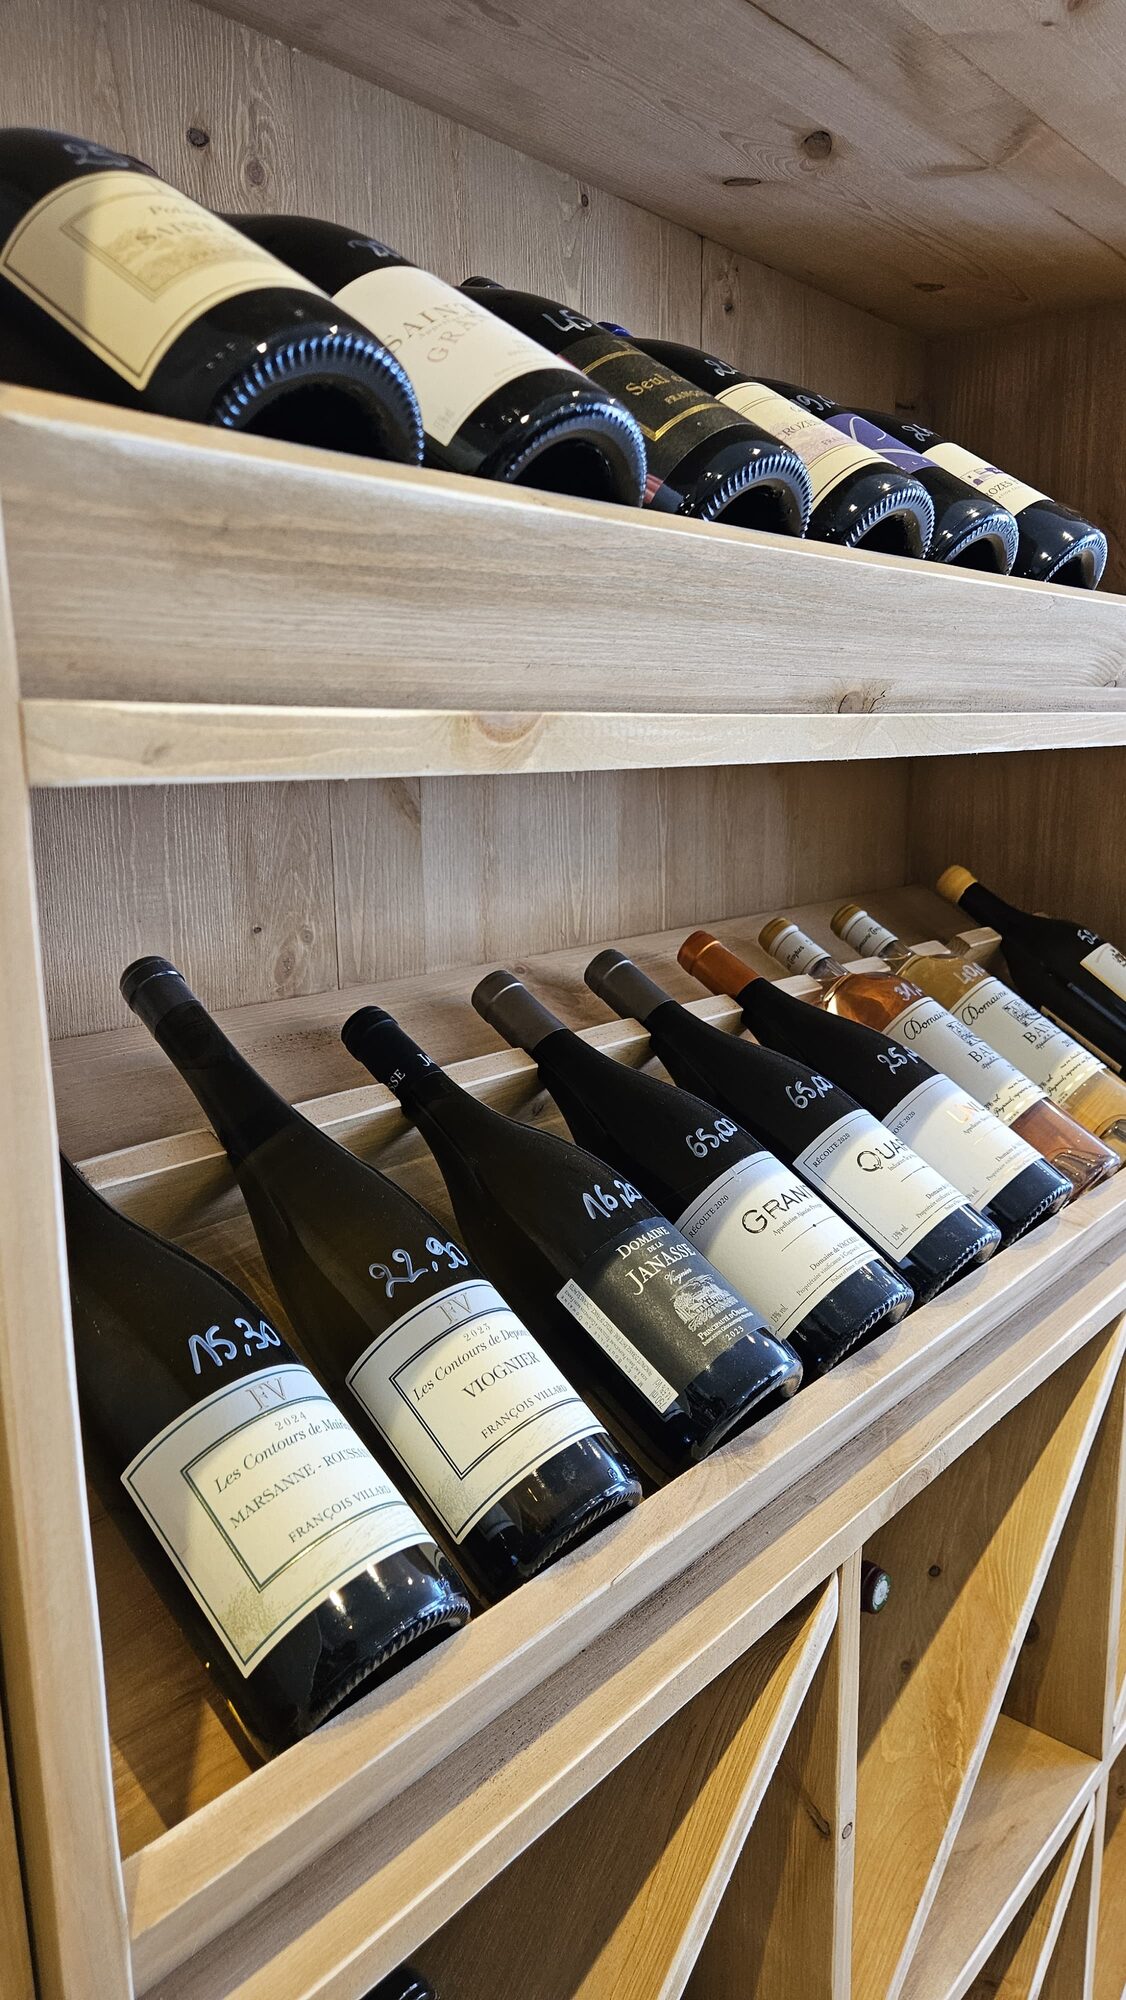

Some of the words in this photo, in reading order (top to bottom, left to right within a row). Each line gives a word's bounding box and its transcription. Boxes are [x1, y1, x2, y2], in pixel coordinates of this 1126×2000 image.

[625, 373, 669, 396] Seul
[785, 1075, 834, 1109] 65,00
[685, 1117, 739, 1158] 65,00
[811, 1141, 839, 1169] RÉCOLTE
[836, 1132, 851, 1147] 2020
[582, 1179, 643, 1221] 16,20
[688, 1206, 717, 1239] RÉCOLTE
[714, 1194, 730, 1210] 2020
[615, 1225, 670, 1261] DOMAINE
[808, 1248, 835, 1272] Domaine
[624, 1242, 697, 1296] JANASSE
[435, 1291, 473, 1326] FV
[187, 1317, 281, 1375] 15,30
[725, 1325, 745, 1342] 2023
[411, 1380, 435, 1402] Les
[433, 1342, 488, 1381] Contours
[487, 1333, 502, 1347] de
[461, 1350, 542, 1400] VIOGNIER
[244, 1376, 287, 1411] FV
[480, 1397, 536, 1440] FRANÇOIS
[533, 1382, 569, 1402] VILLARD
[274, 1410, 308, 1431] 2024
[213, 1469, 242, 1495] Les
[242, 1430, 308, 1471] Contours
[307, 1421, 323, 1436] de
[228, 1462, 317, 1529] MARSANNE
[287, 1496, 354, 1544] FRANÇOIS
[351, 1483, 392, 1503] VILLARD
